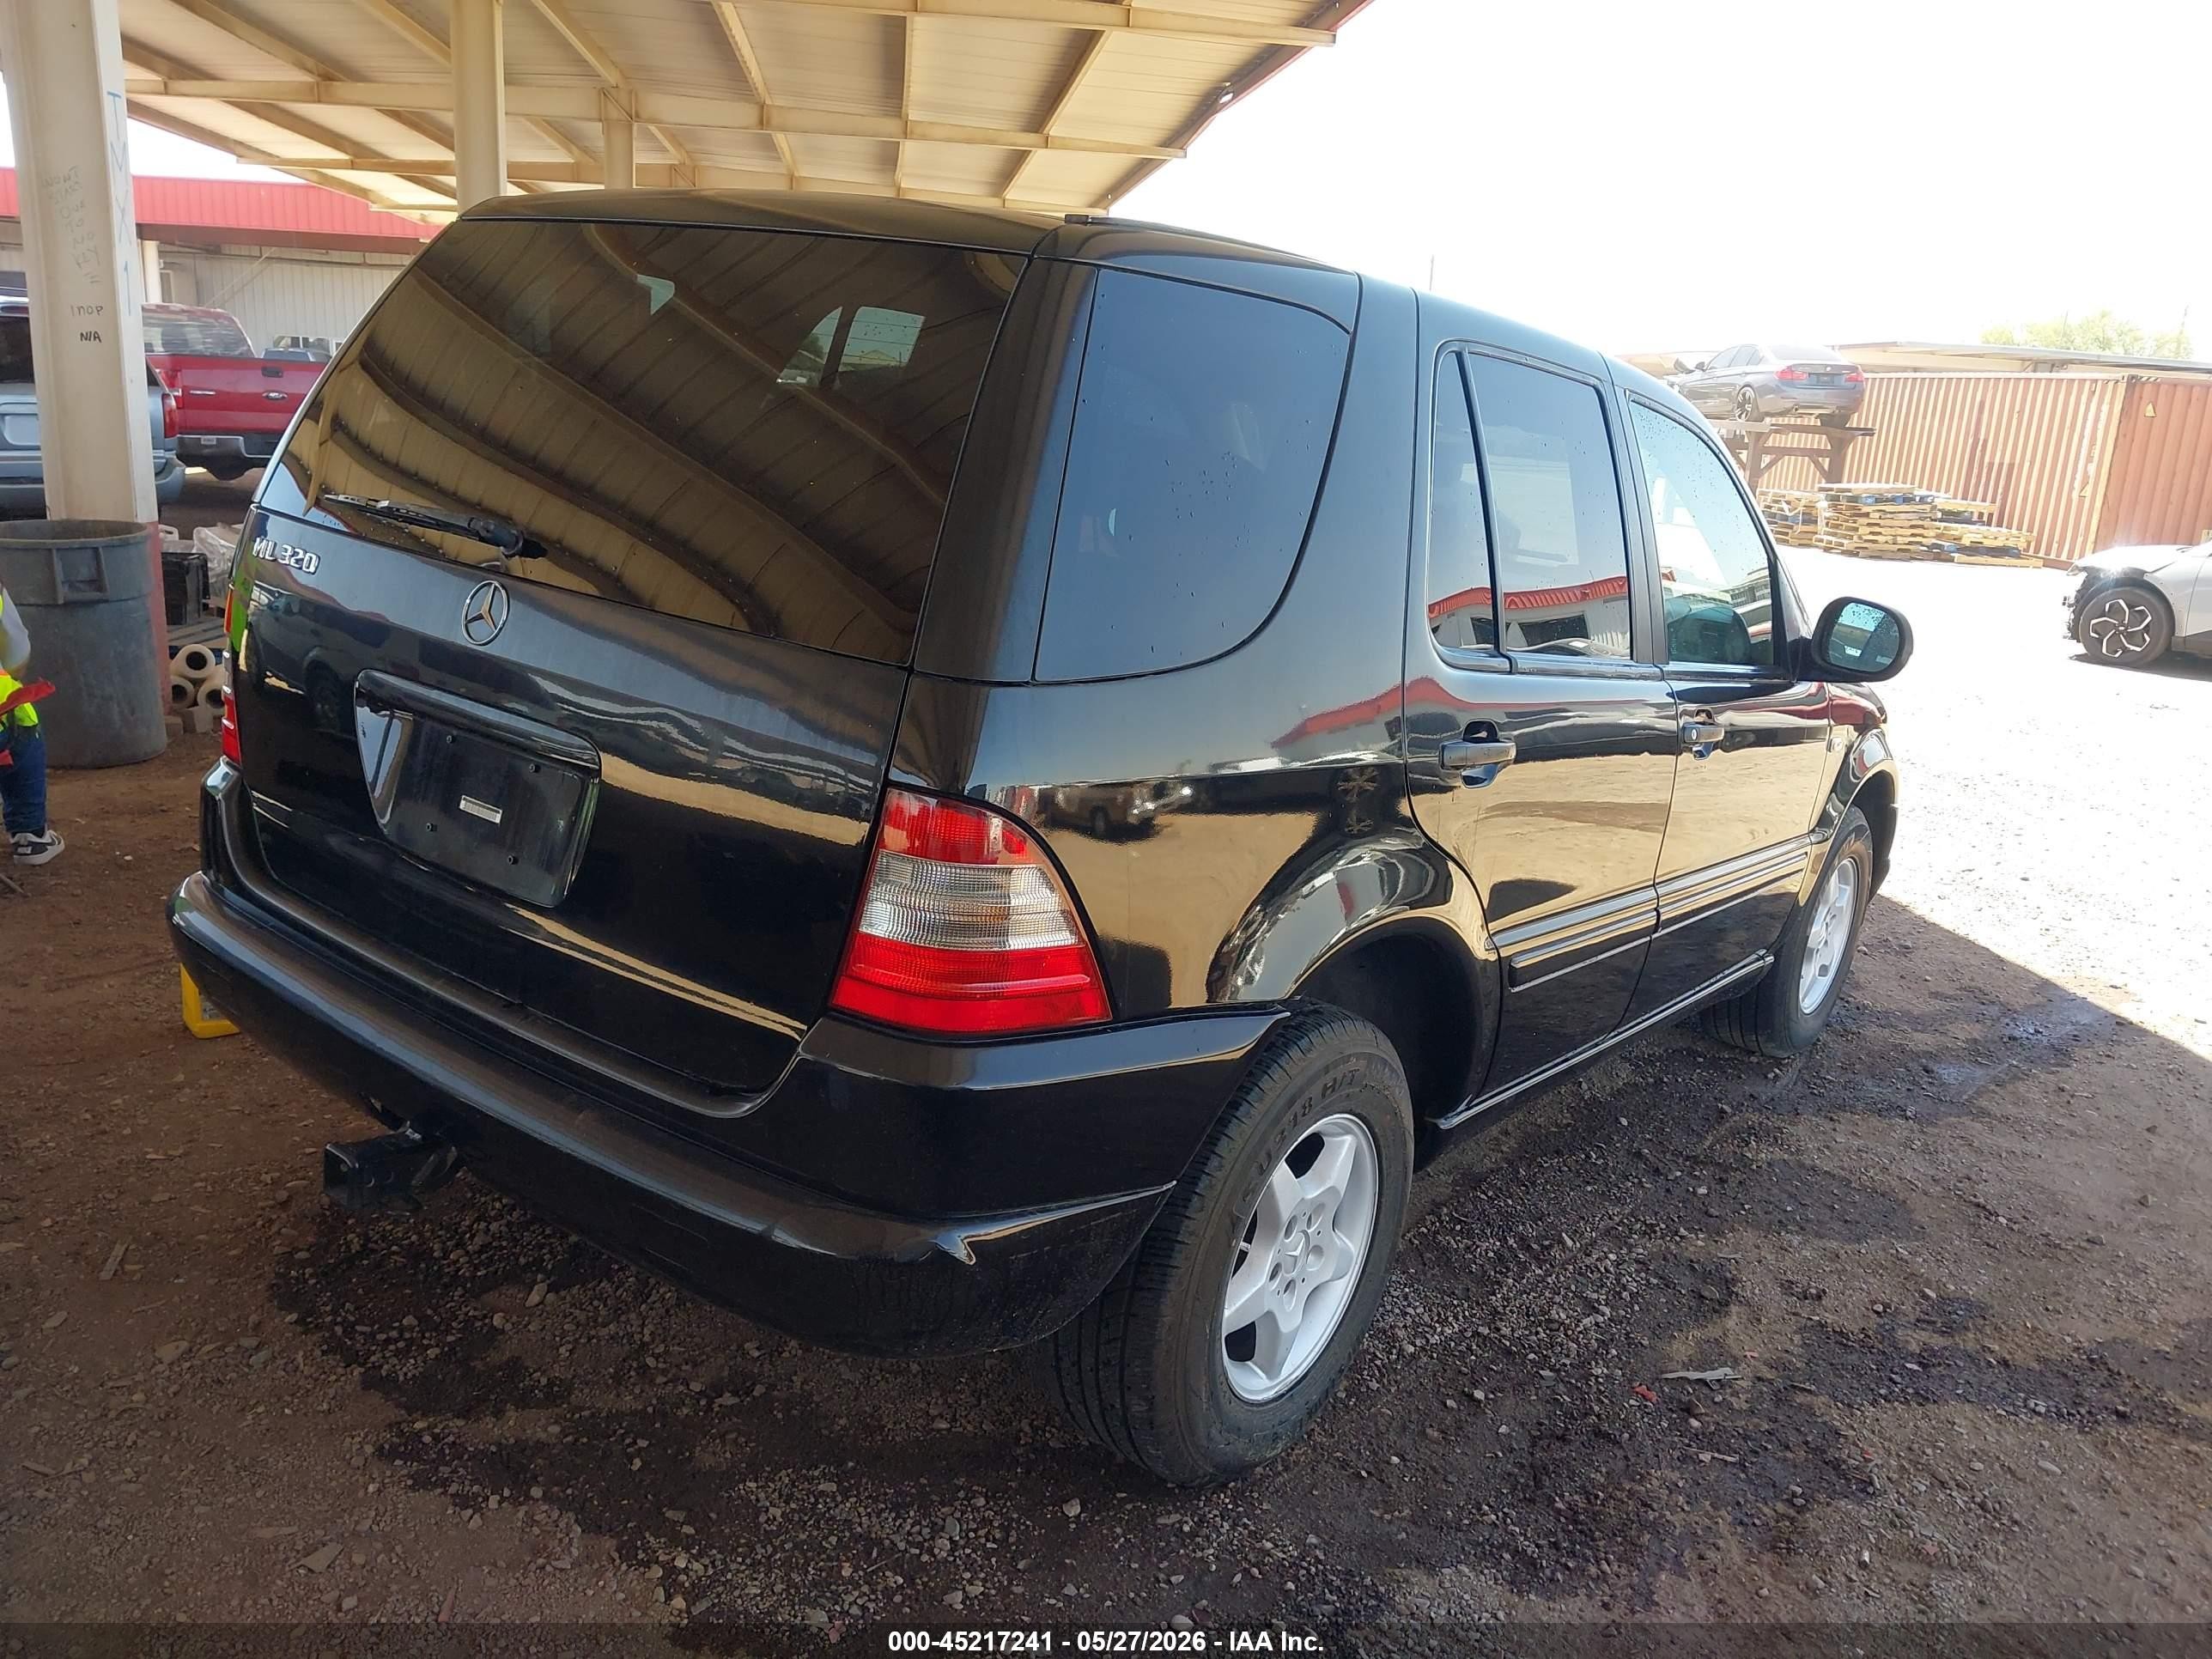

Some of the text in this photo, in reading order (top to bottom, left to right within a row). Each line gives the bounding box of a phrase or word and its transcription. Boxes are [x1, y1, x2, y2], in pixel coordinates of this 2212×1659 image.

[80, 331, 102, 343] N/A
[252, 536, 320, 574] ML 320
